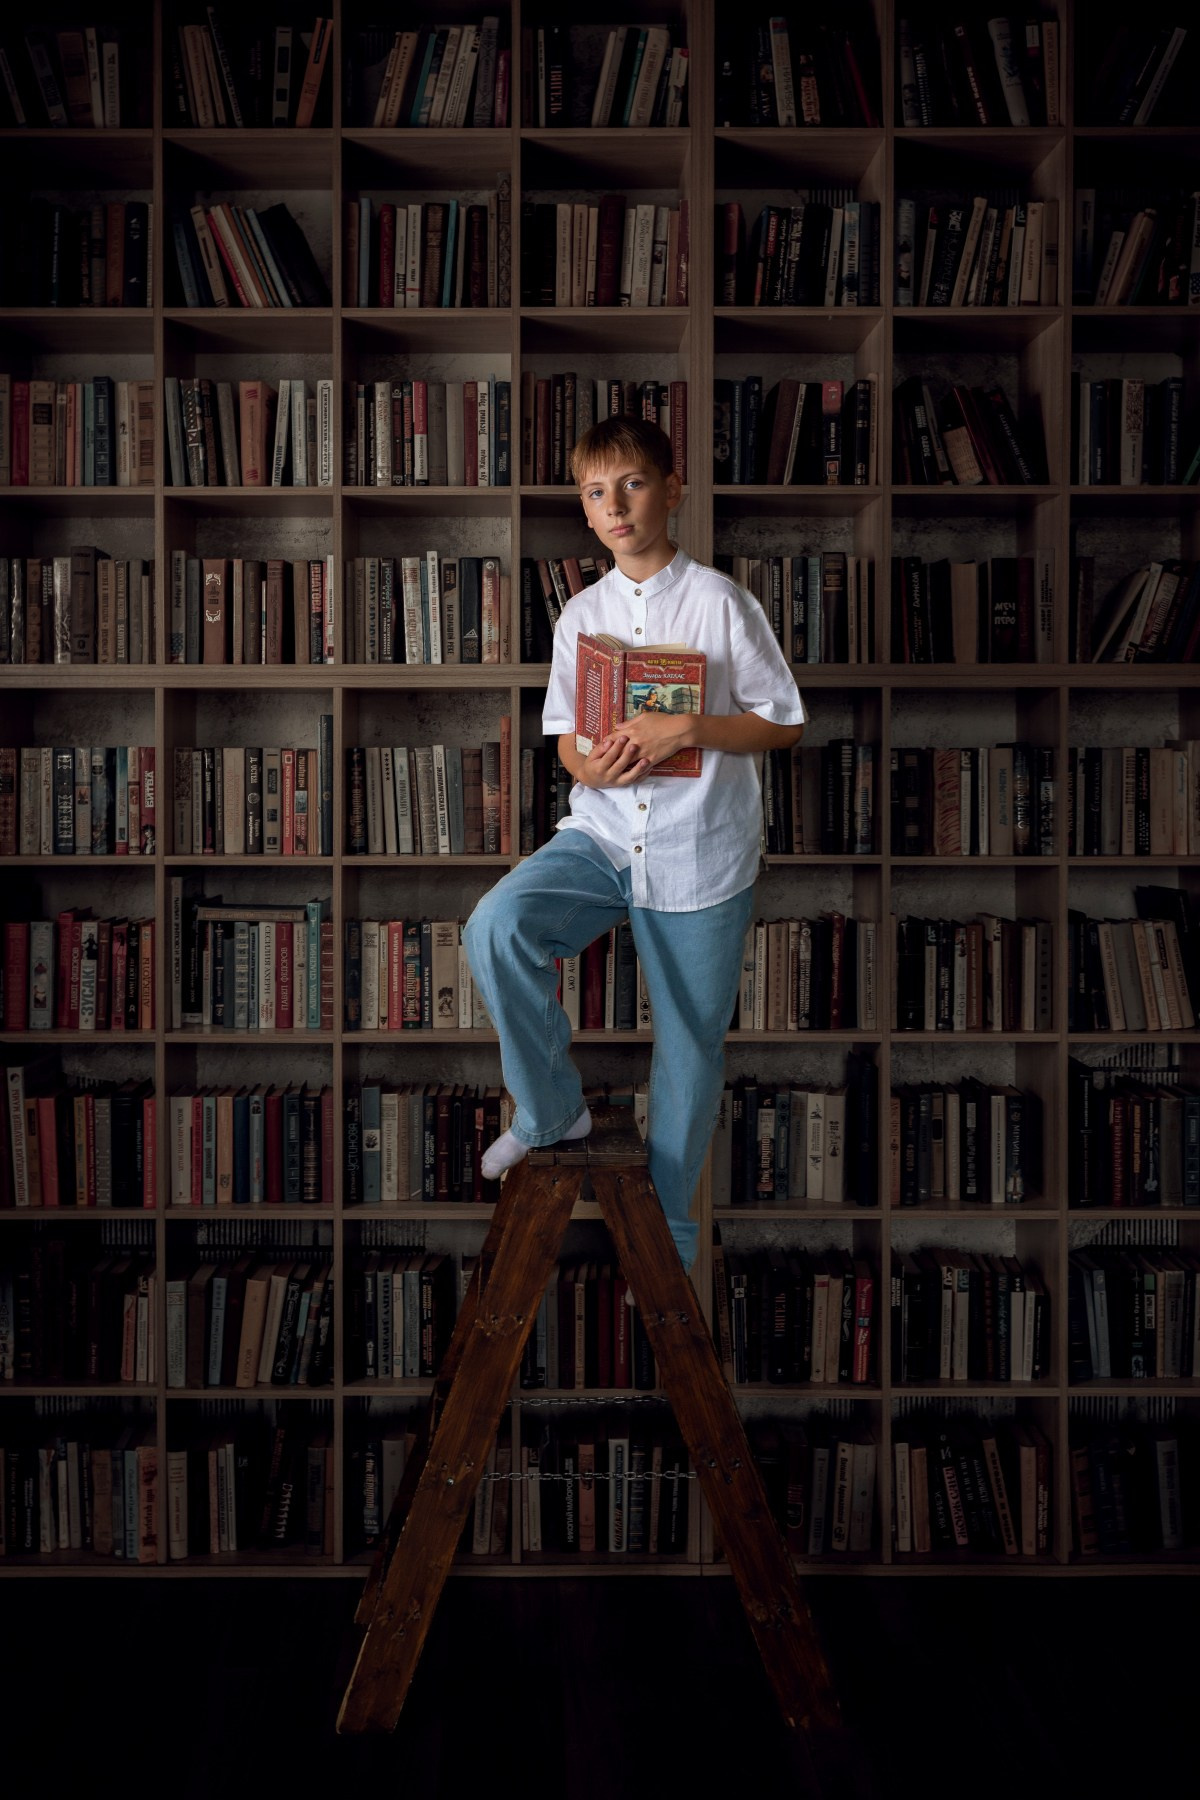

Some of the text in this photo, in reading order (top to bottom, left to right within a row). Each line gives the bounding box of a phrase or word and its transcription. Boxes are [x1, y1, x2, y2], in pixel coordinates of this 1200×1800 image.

[611, 385, 620, 415] СМЕРТИ
[994, 603, 1015, 612] МЕЧ
[994, 616, 1016, 625] ПЕРО
[447, 641, 455, 655] РЕКЕ
[437, 767, 447, 837] ЭКОНОМИЧЕСКАЯ ТЕОРИЯ
[71, 947, 80, 1010] ПАВЕЛ ФЕДОРОВ
[81, 969, 95, 1017] ЗУСАК
[142, 957, 151, 1009] АНЕКДОТЫ
[280, 947, 289, 1010] ПАВЕЛ ФЕДОРОВ
[309, 943, 317, 1010] АДРЕСА СПАСЕНИЯ
[405, 963, 417, 999] ПЕРУМОВ
[567, 975, 577, 992] ДЖО
[11, 1089, 26, 1203] ЭНЦИКЛОПЕДИЯ БУДУЩЕЙ МАМЫ
[347, 1123, 360, 1171] УСТИНОВА
[760, 1135, 772, 1183] Ник ПЕРУМОВ
[566, 1511, 574, 1543] НИКОЛАЙ
[953, 1500, 967, 1539] ЖОРЖ
